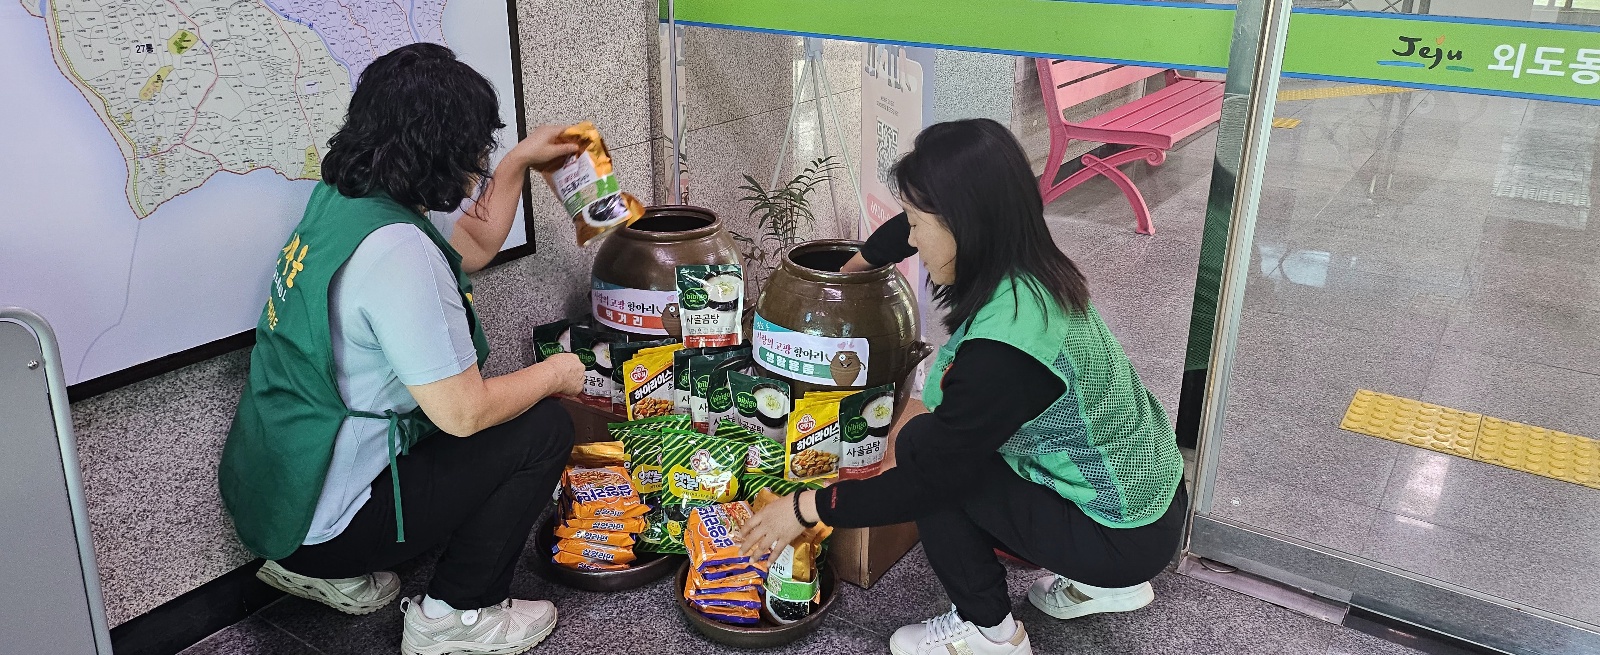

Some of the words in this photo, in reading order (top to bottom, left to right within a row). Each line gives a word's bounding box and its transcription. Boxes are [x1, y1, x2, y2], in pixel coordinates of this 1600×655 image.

[1392, 35, 1463, 69] Jeju
[1488, 43, 1600, 84] 외도동
[627, 301, 655, 315] 항아리
[686, 313, 720, 325] 사골곰탕
[793, 346, 824, 362] 항아리
[634, 369, 673, 400] 하이라이스
[737, 395, 757, 408] bibigo
[847, 420, 867, 433] bibigo
[846, 440, 880, 457] 사골곰탕
